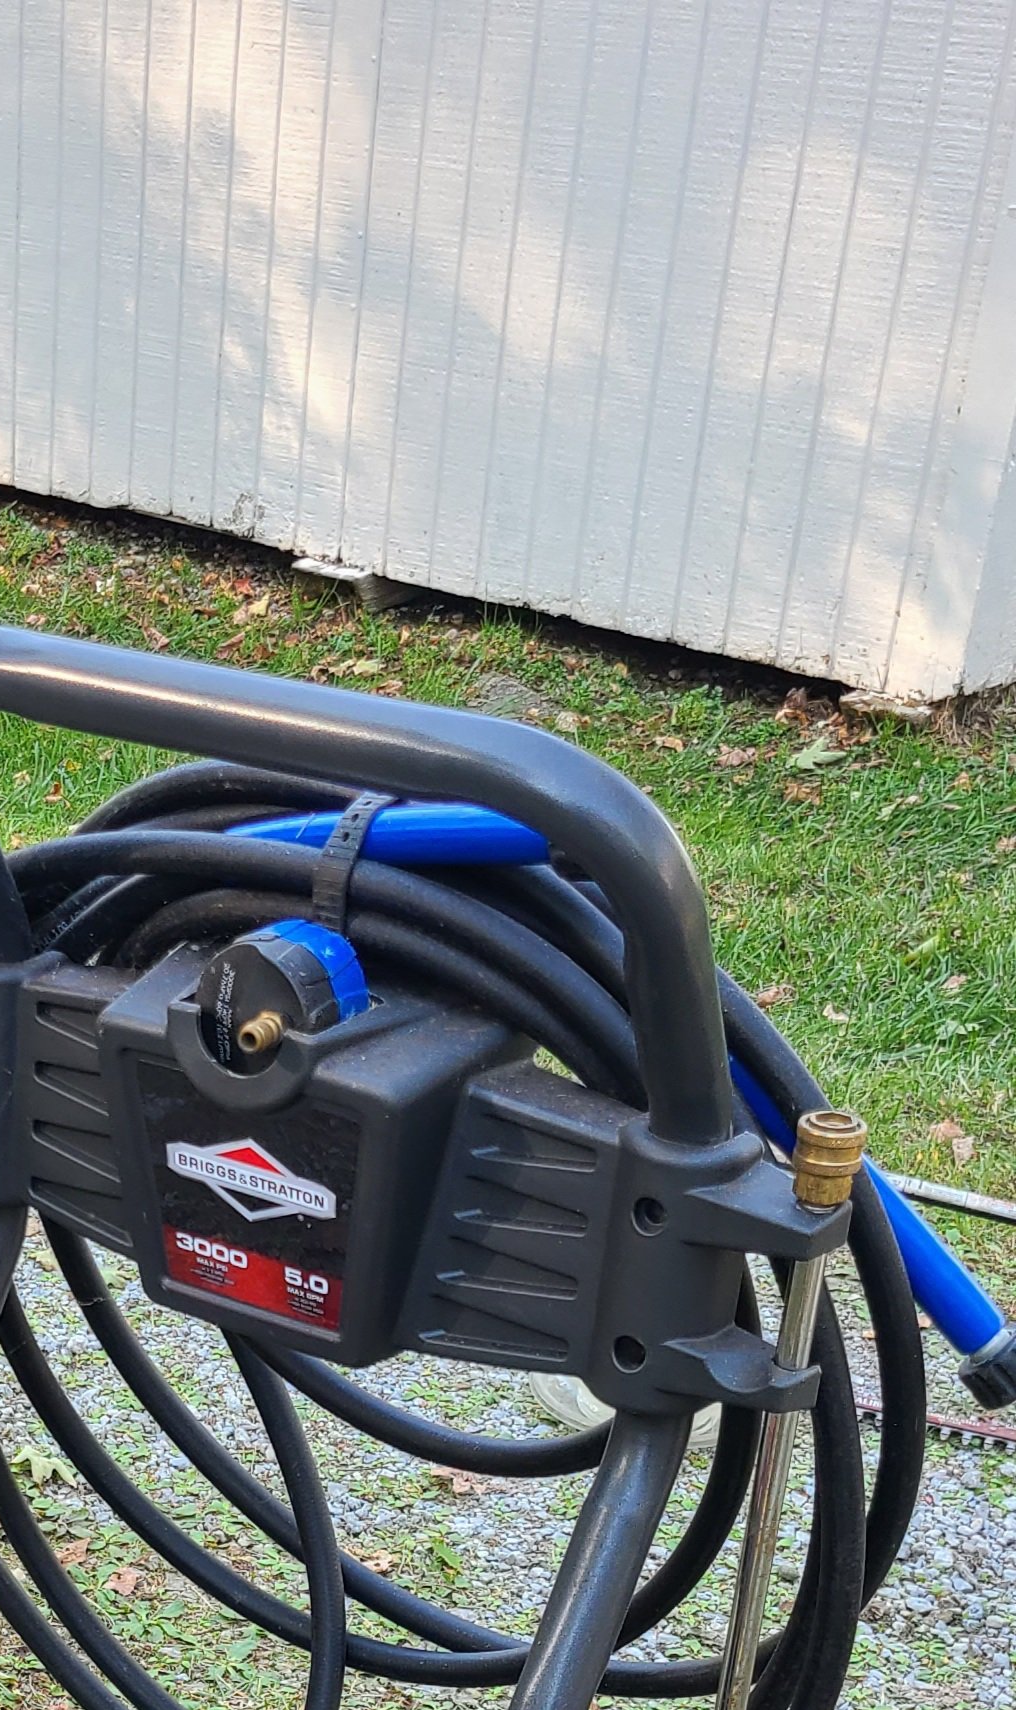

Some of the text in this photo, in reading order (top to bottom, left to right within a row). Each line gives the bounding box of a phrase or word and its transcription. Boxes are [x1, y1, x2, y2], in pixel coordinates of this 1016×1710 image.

[175, 1232, 248, 1269] 3000
[196, 1257, 214, 1268] MAX
[284, 1266, 329, 1295] 5.0
[287, 1286, 305, 1299] MAX
